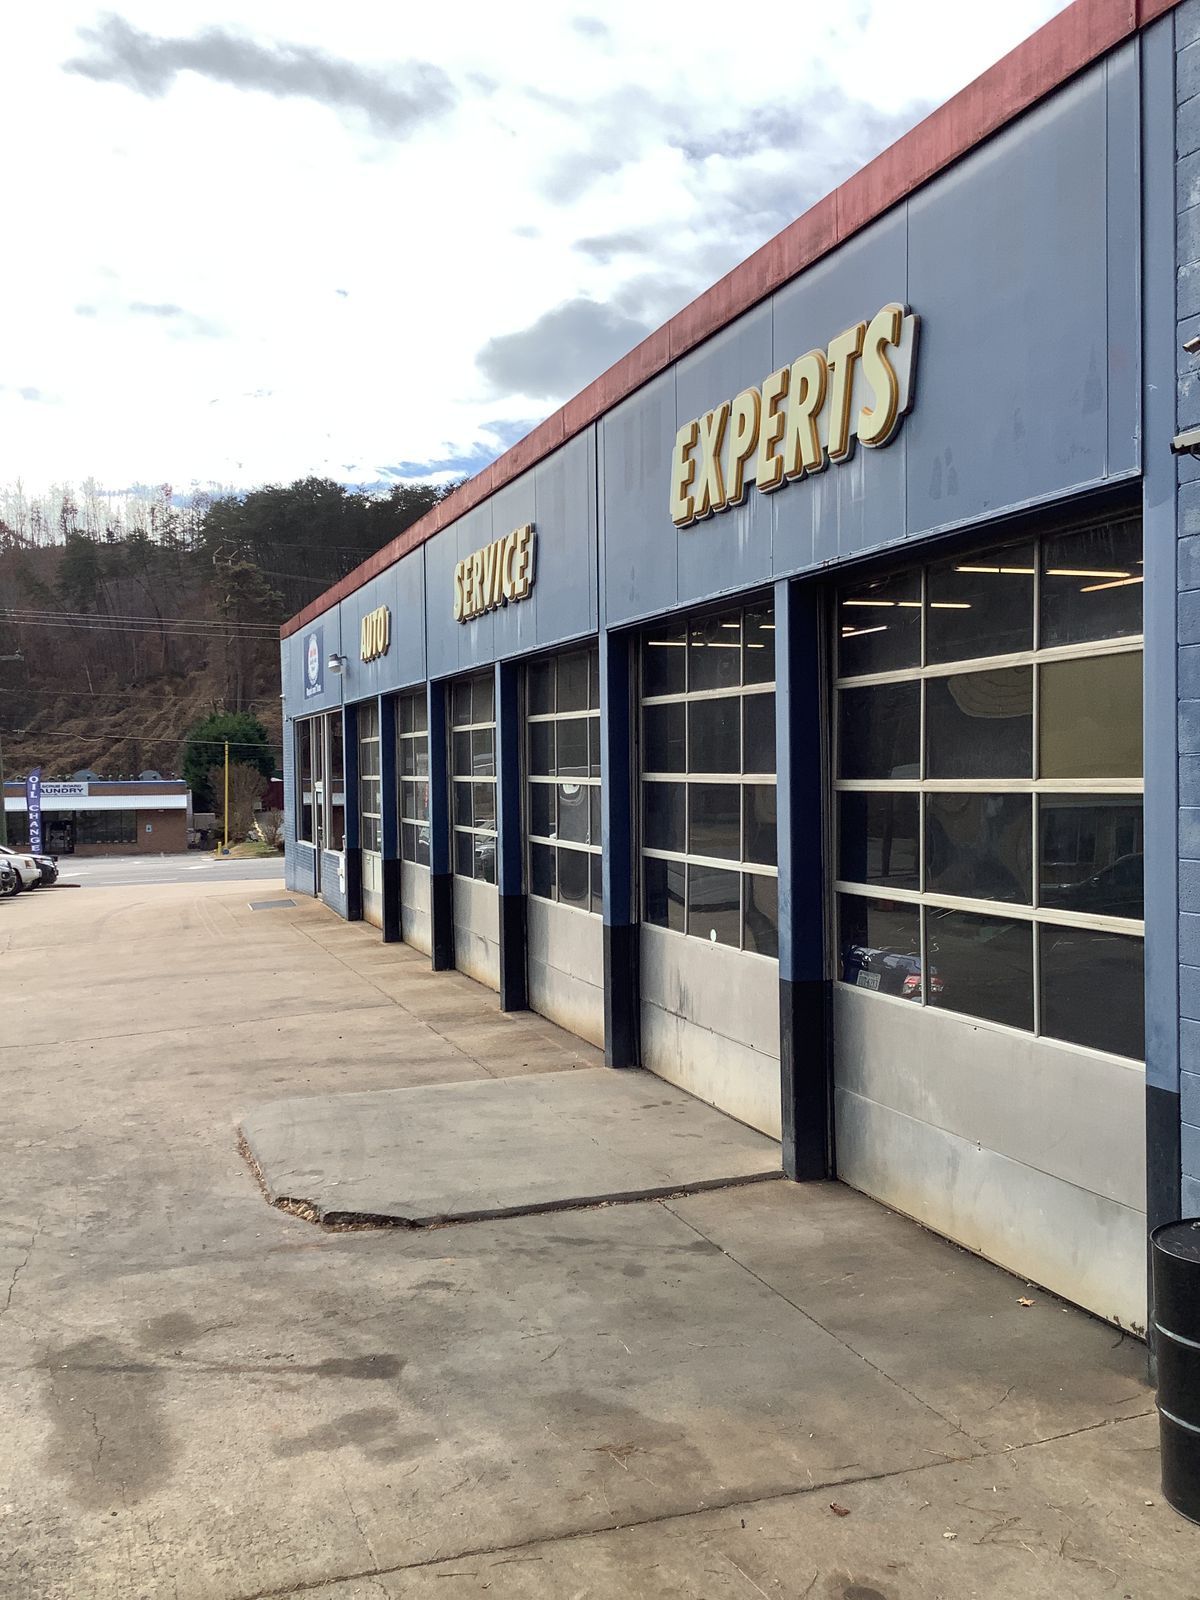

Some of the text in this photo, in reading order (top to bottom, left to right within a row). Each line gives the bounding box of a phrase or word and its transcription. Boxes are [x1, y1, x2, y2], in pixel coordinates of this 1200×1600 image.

[360, 304, 907, 662] AUTO SERVICE EXPERTS
[28, 775, 41, 852] OIL CHANGE
